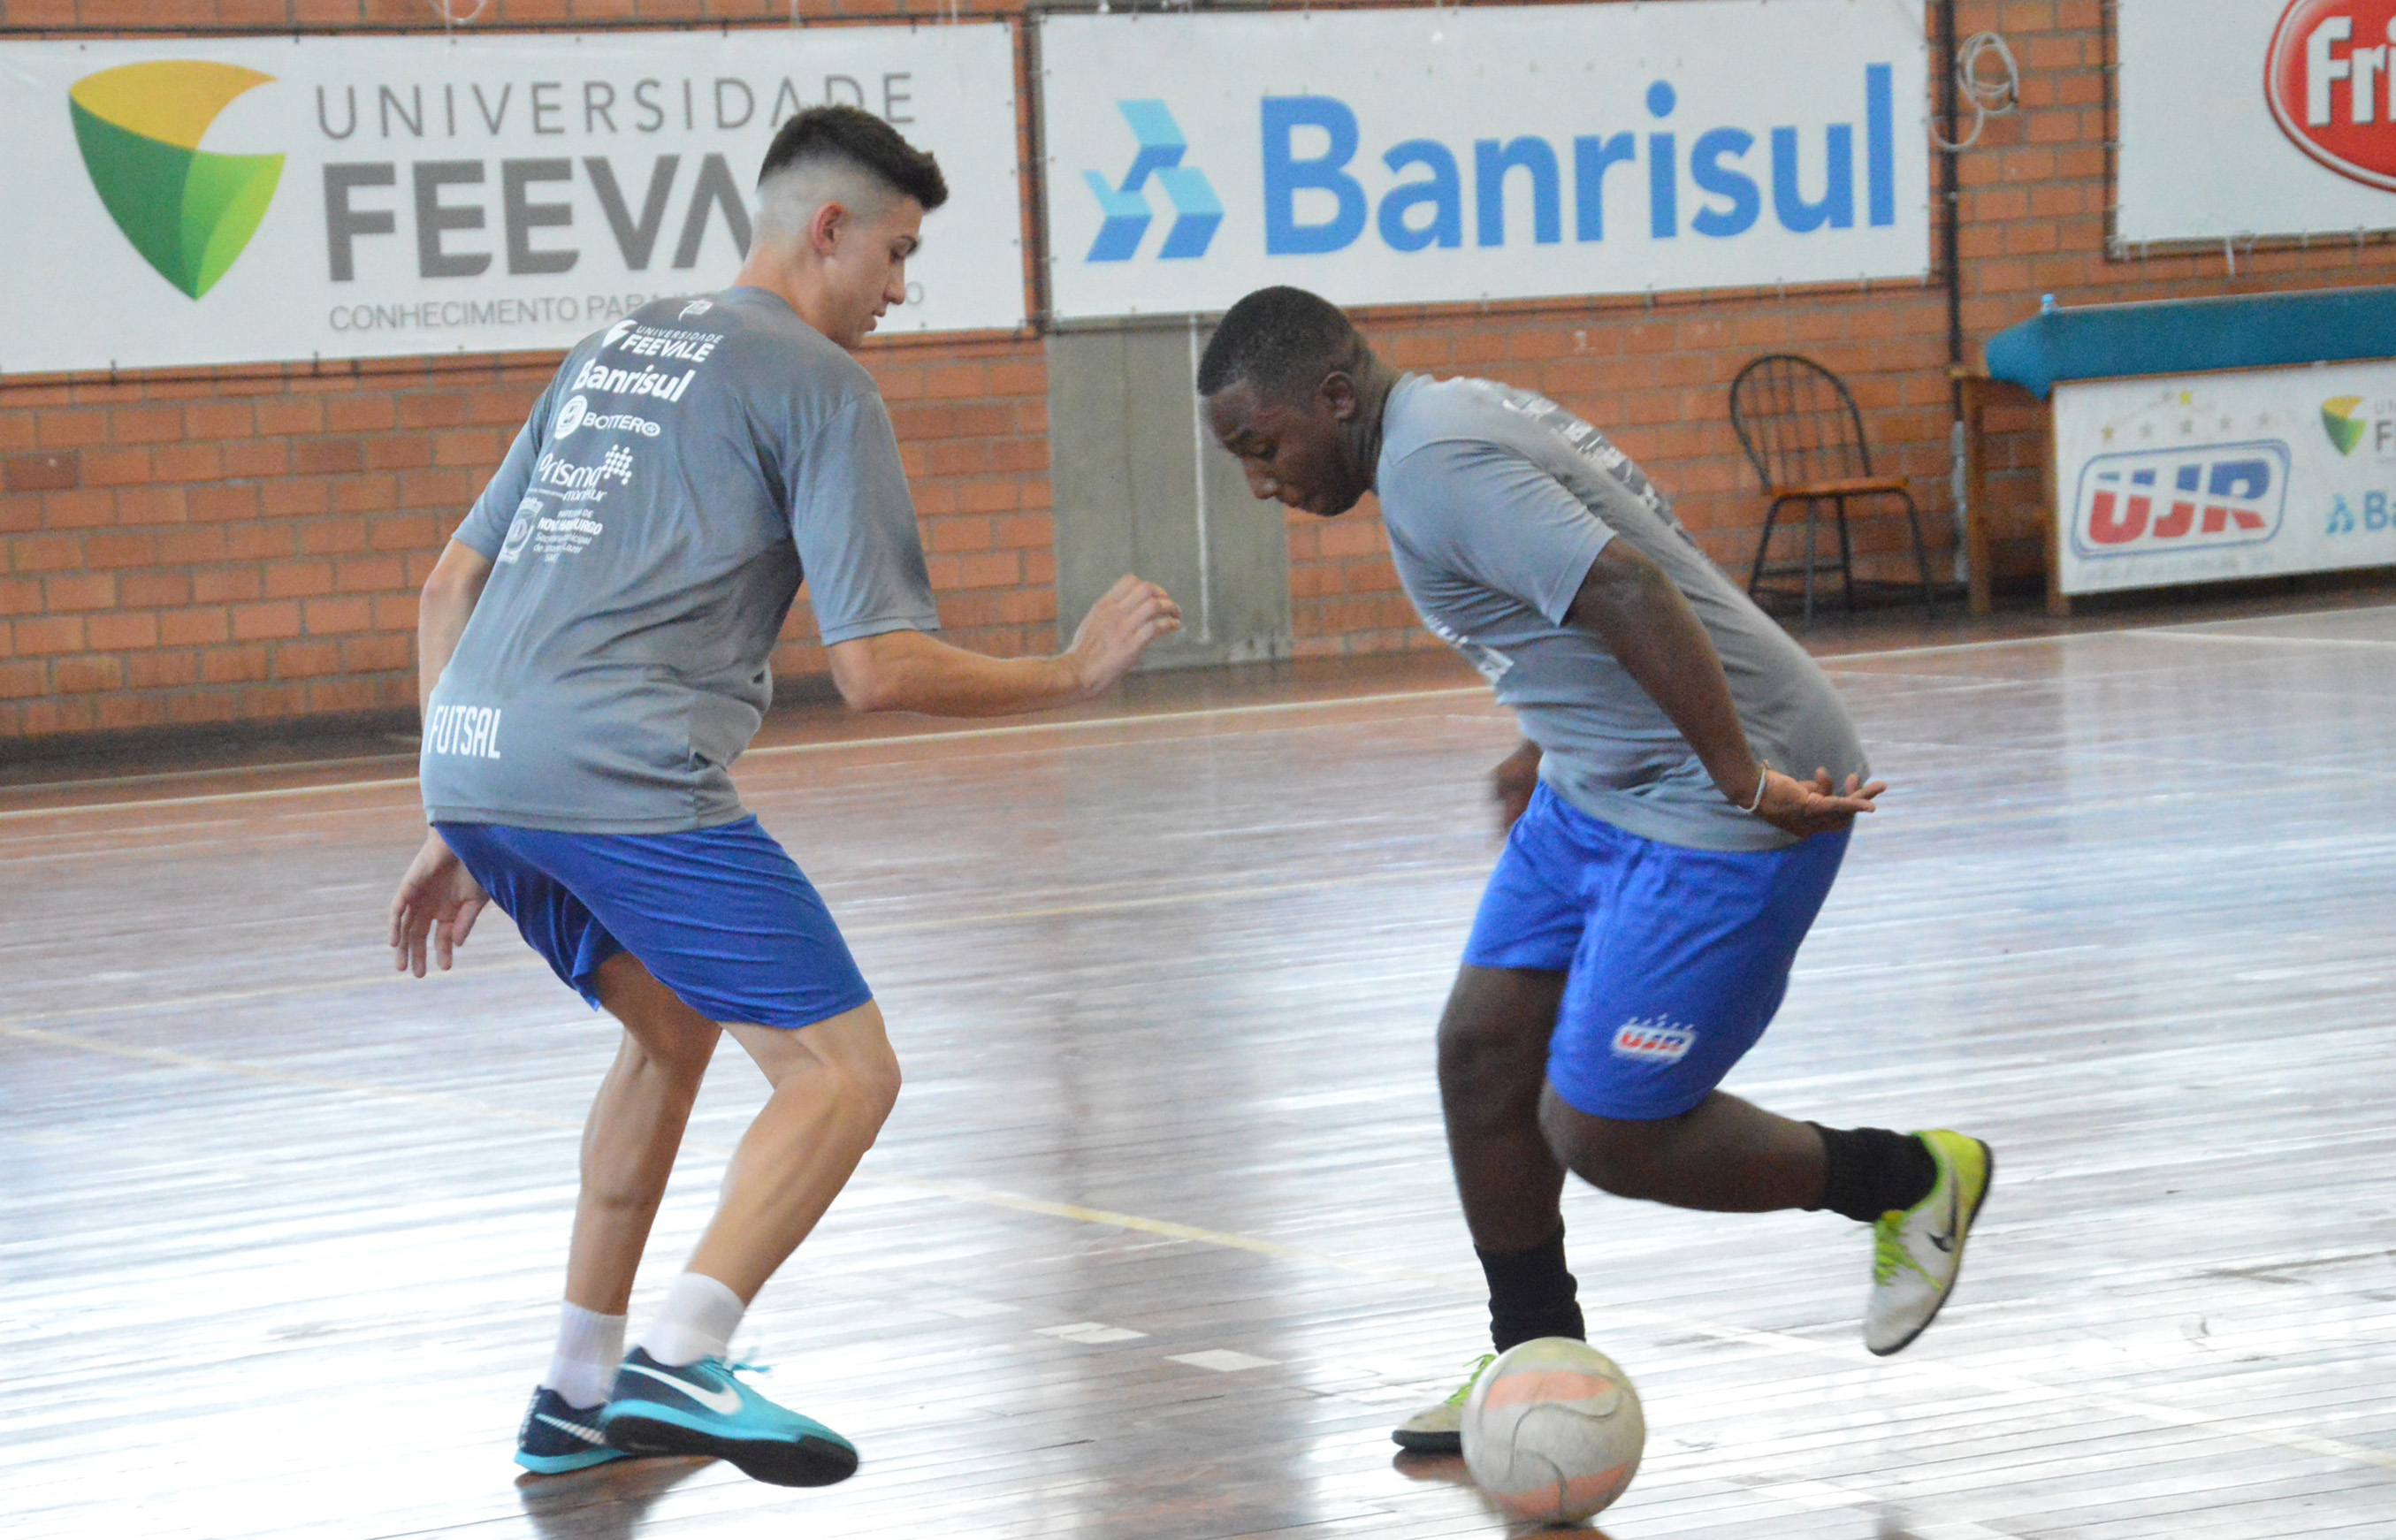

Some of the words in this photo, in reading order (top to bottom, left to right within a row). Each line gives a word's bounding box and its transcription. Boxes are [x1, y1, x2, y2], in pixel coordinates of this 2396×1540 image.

[316, 72, 915, 140] UNIVERSIDADE
[1259, 62, 1896, 255] Banrisul
[322, 153, 752, 282] FEEVA
[328, 295, 578, 332] CONHECIMENTO
[585, 293, 661, 322] PAR
[635, 324, 724, 345] UNIVERSIDADE
[619, 332, 716, 363] FEEVALE
[571, 358, 697, 402] Banrisul
[428, 705, 502, 759] FUTSAL
